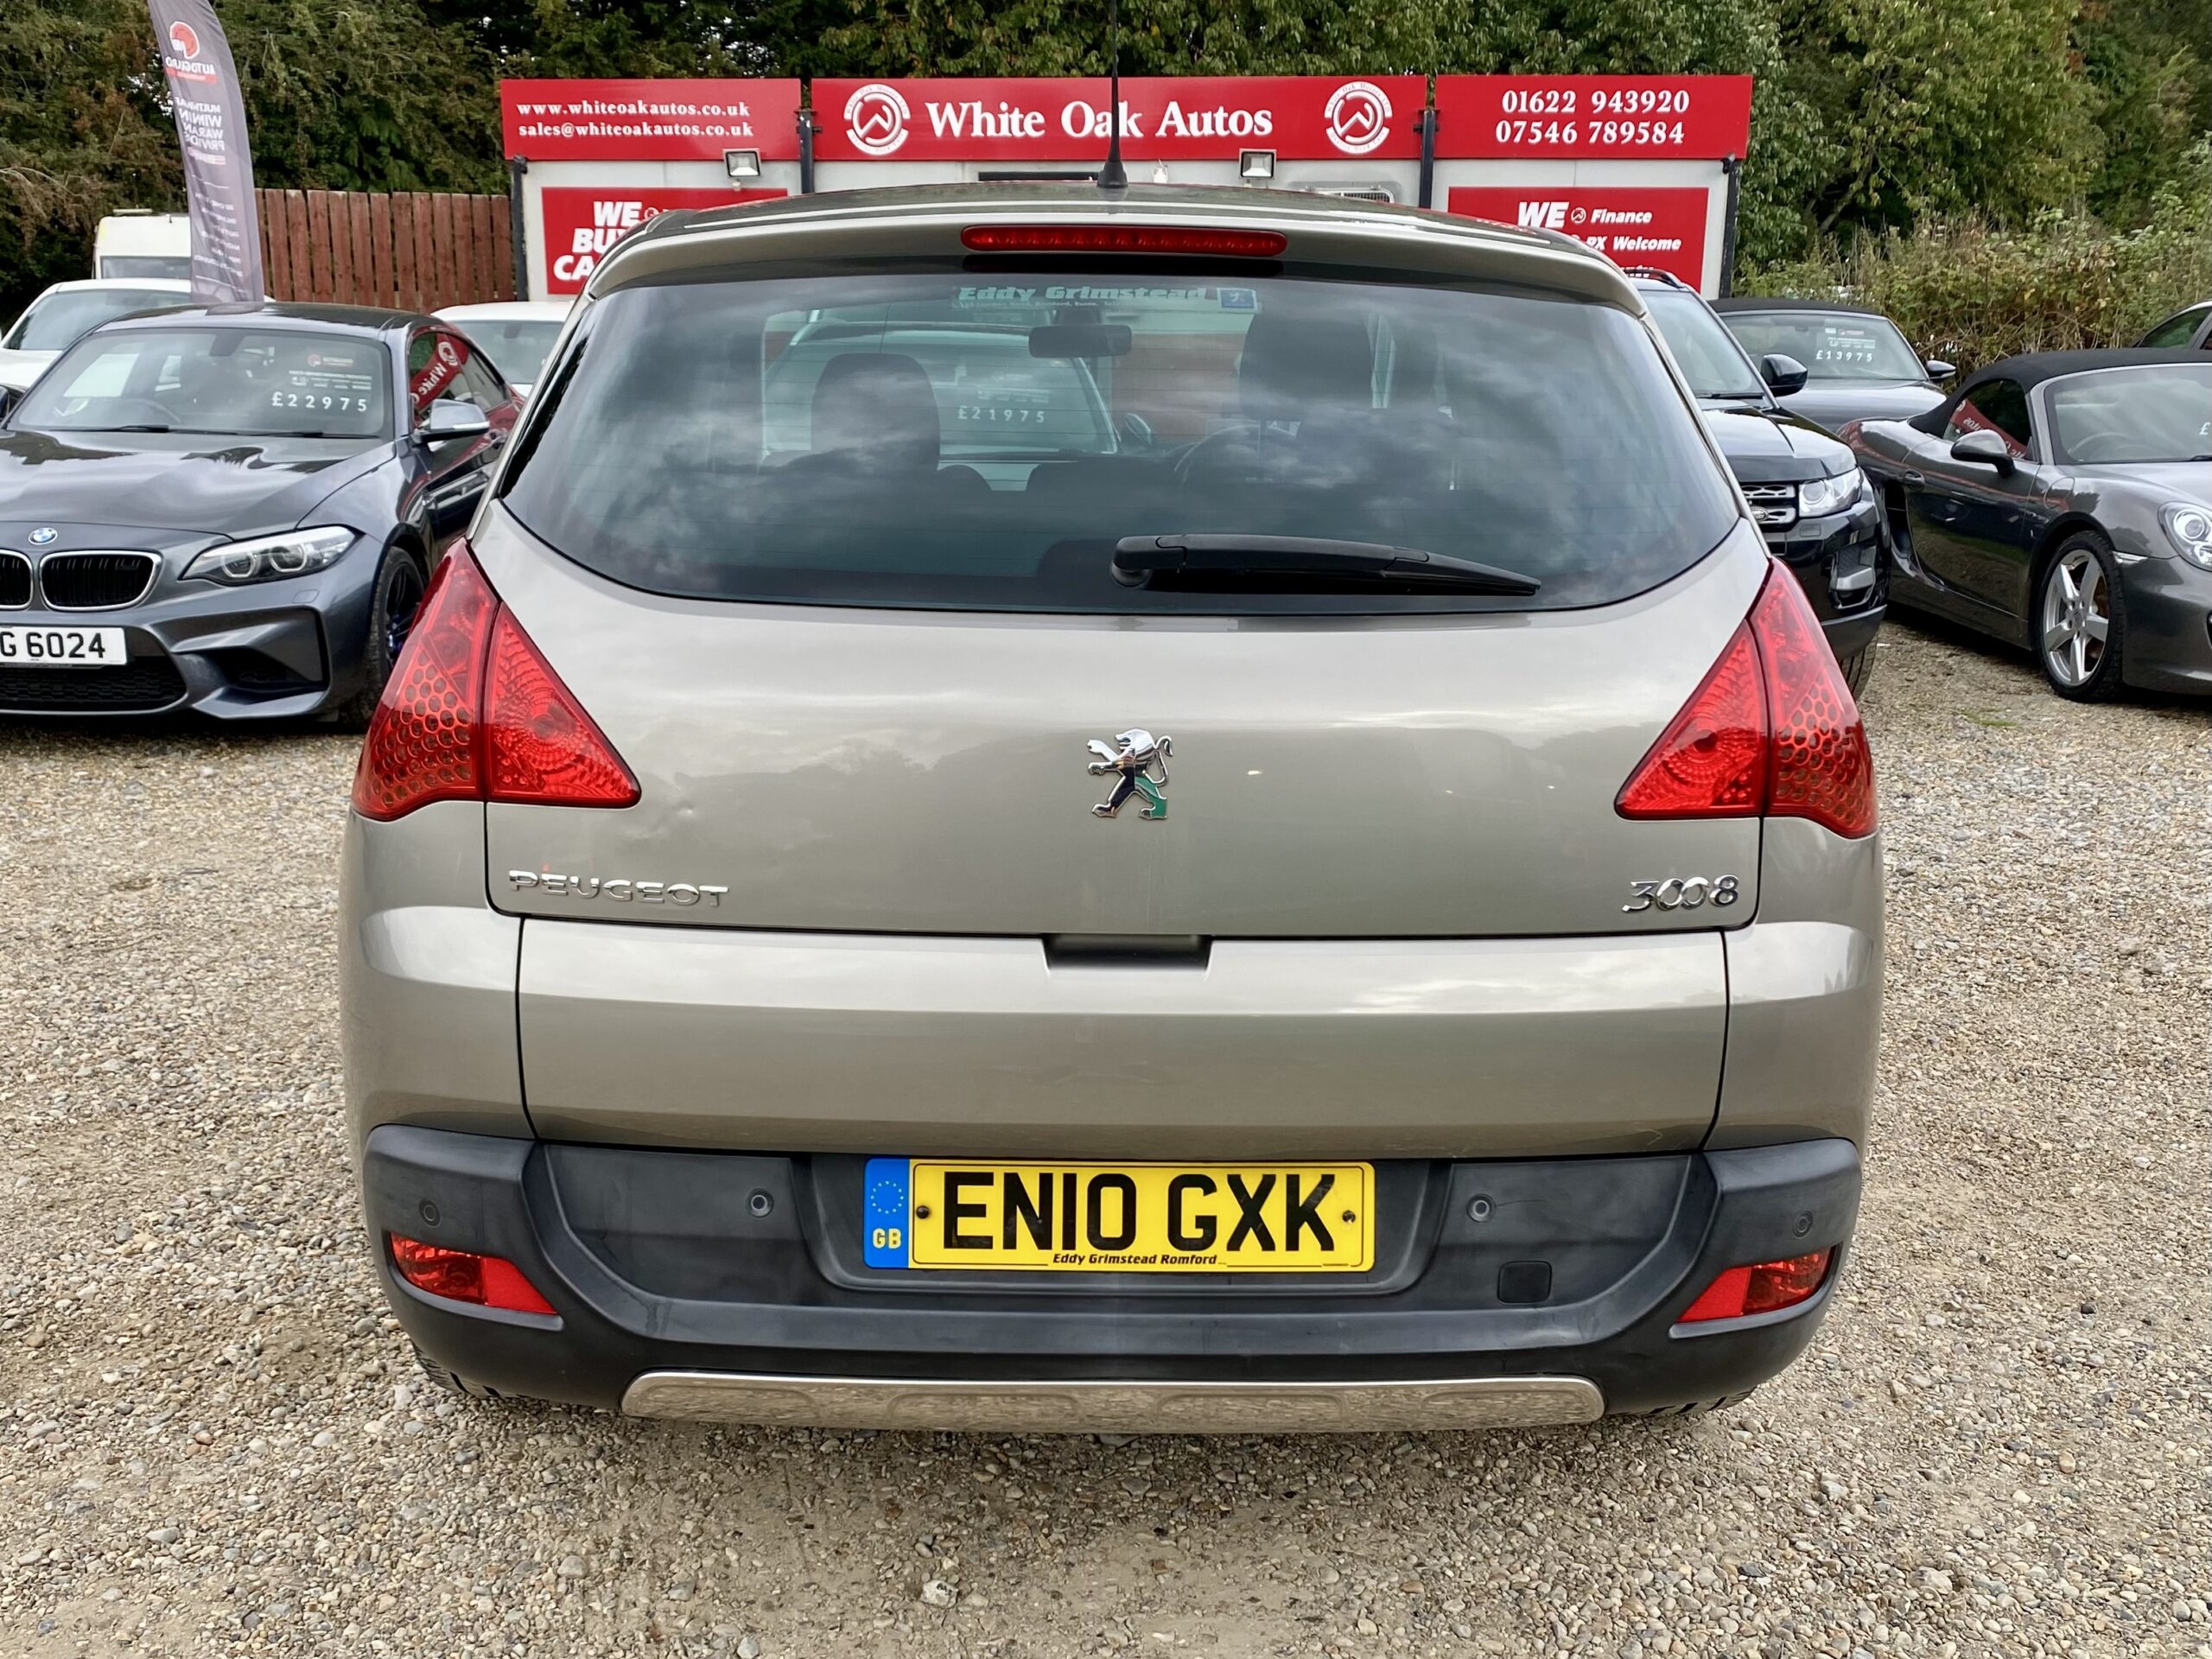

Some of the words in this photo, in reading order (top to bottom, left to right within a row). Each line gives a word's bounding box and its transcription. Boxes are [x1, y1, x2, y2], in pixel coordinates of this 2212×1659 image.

[517, 100, 750, 116] www.whiteoakautos.co.uk
[1502, 90, 1576, 113] 01622
[1592, 90, 1690, 113] 943920
[518, 122, 753, 137] sales@whiteoakautos.co.uk
[925, 101, 1046, 137] White
[1061, 100, 1143, 137] Oak
[1155, 100, 1274, 137] Autos
[1496, 120, 1578, 143] 07546
[1589, 121, 1684, 144] 789584
[594, 200, 642, 227] WE
[1517, 201, 1569, 229] WE
[1590, 208, 1652, 224] Finance
[1586, 236, 1607, 251] PX
[1613, 236, 1681, 251] Welcome
[958, 286, 1037, 302] Eddy
[1046, 286, 1206, 300] Grimstead
[1816, 350, 1872, 361] £13975
[271, 391, 367, 412] £22975
[957, 405, 1045, 423] £21975
[26, 632, 105, 658] 6024
[509, 870, 730, 907] PEUGEOT
[1622, 874, 1739, 913] 3008
[1167, 1173, 1336, 1252] GXK
[873, 1229, 902, 1250] GB
[1052, 1253, 1085, 1268] Eddy
[1088, 1253, 1157, 1266] Grimstead
[1160, 1253, 1217, 1266] Romford
